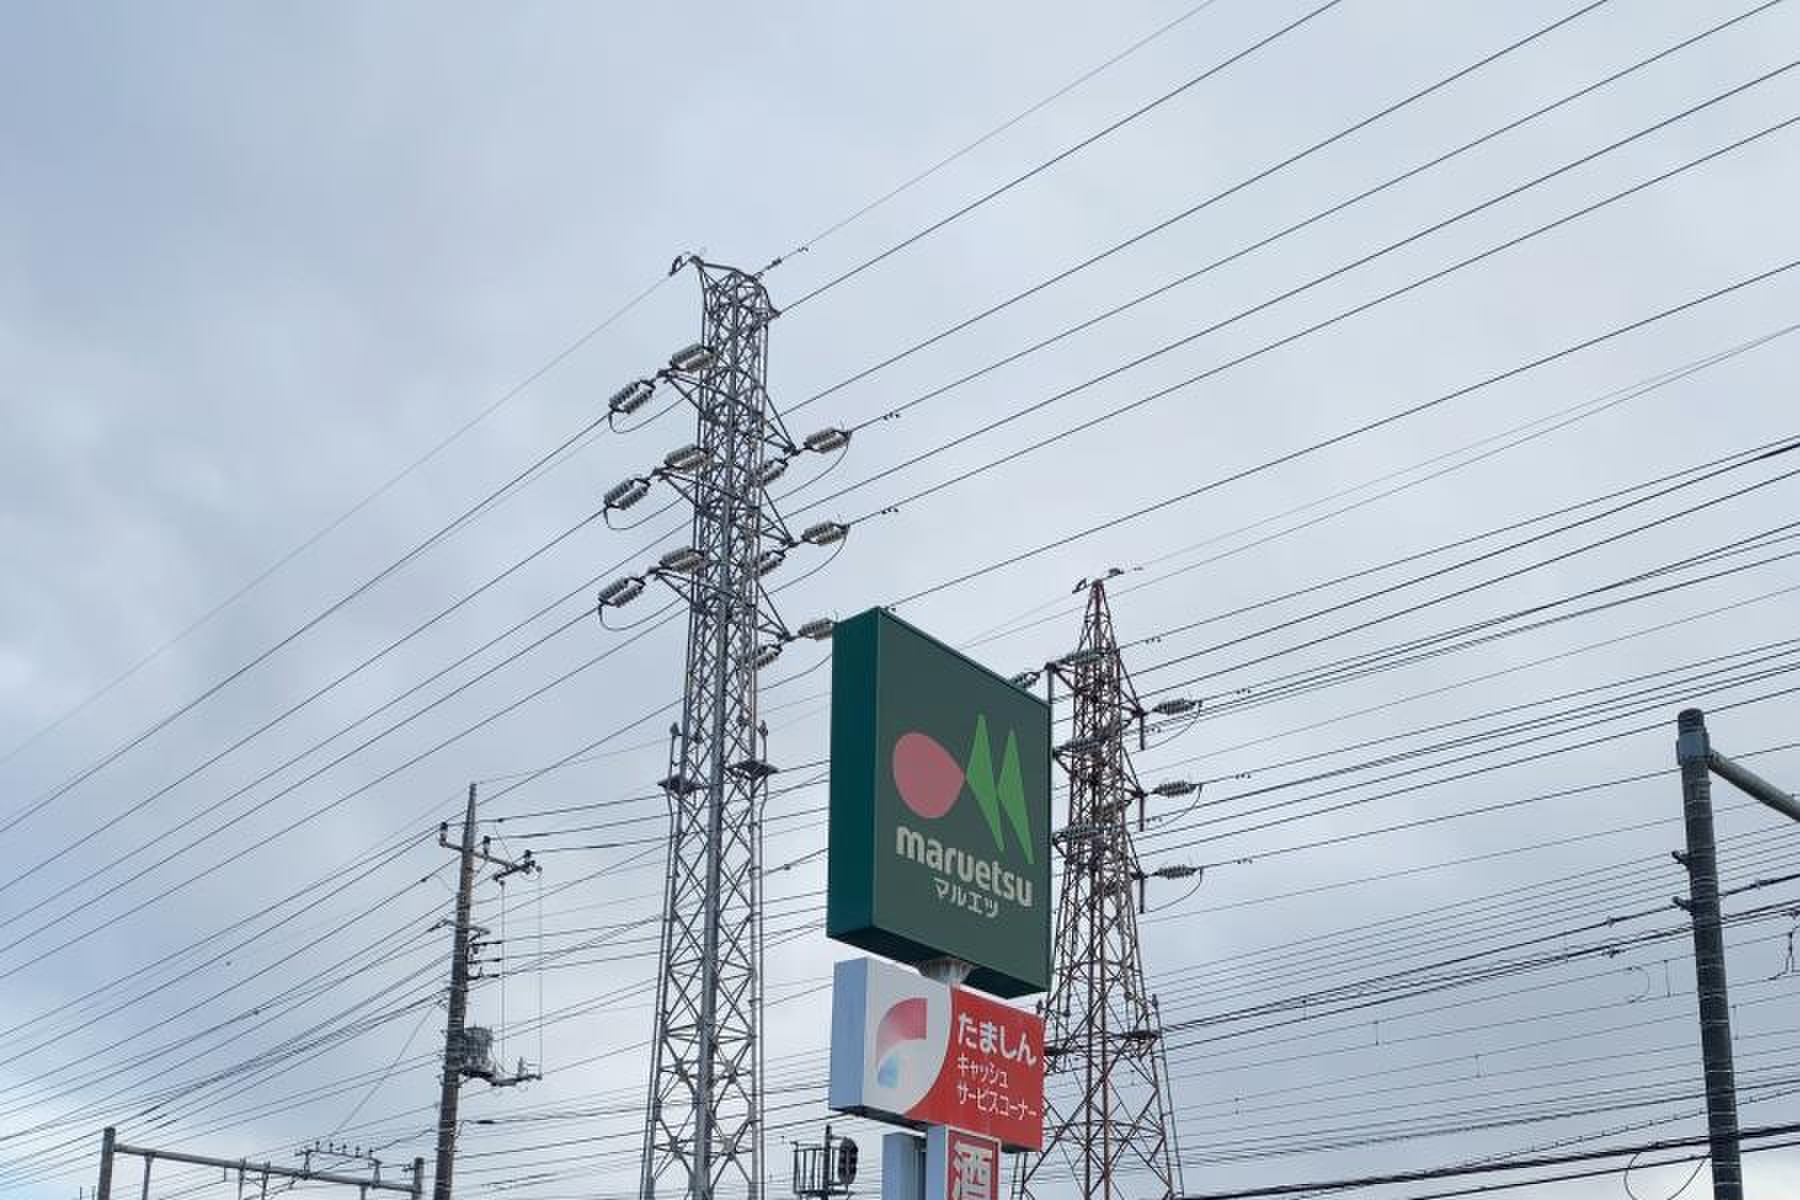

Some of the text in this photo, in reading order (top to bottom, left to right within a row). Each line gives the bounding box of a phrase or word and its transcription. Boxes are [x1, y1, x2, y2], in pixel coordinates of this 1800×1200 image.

[896, 825, 1033, 907] maruetsu
[934, 876, 999, 918] マルエツ
[958, 1012, 1037, 1066] たましん
[957, 1052, 1009, 1089] キャッシュ
[957, 1081, 1037, 1121] サービスコーナー
